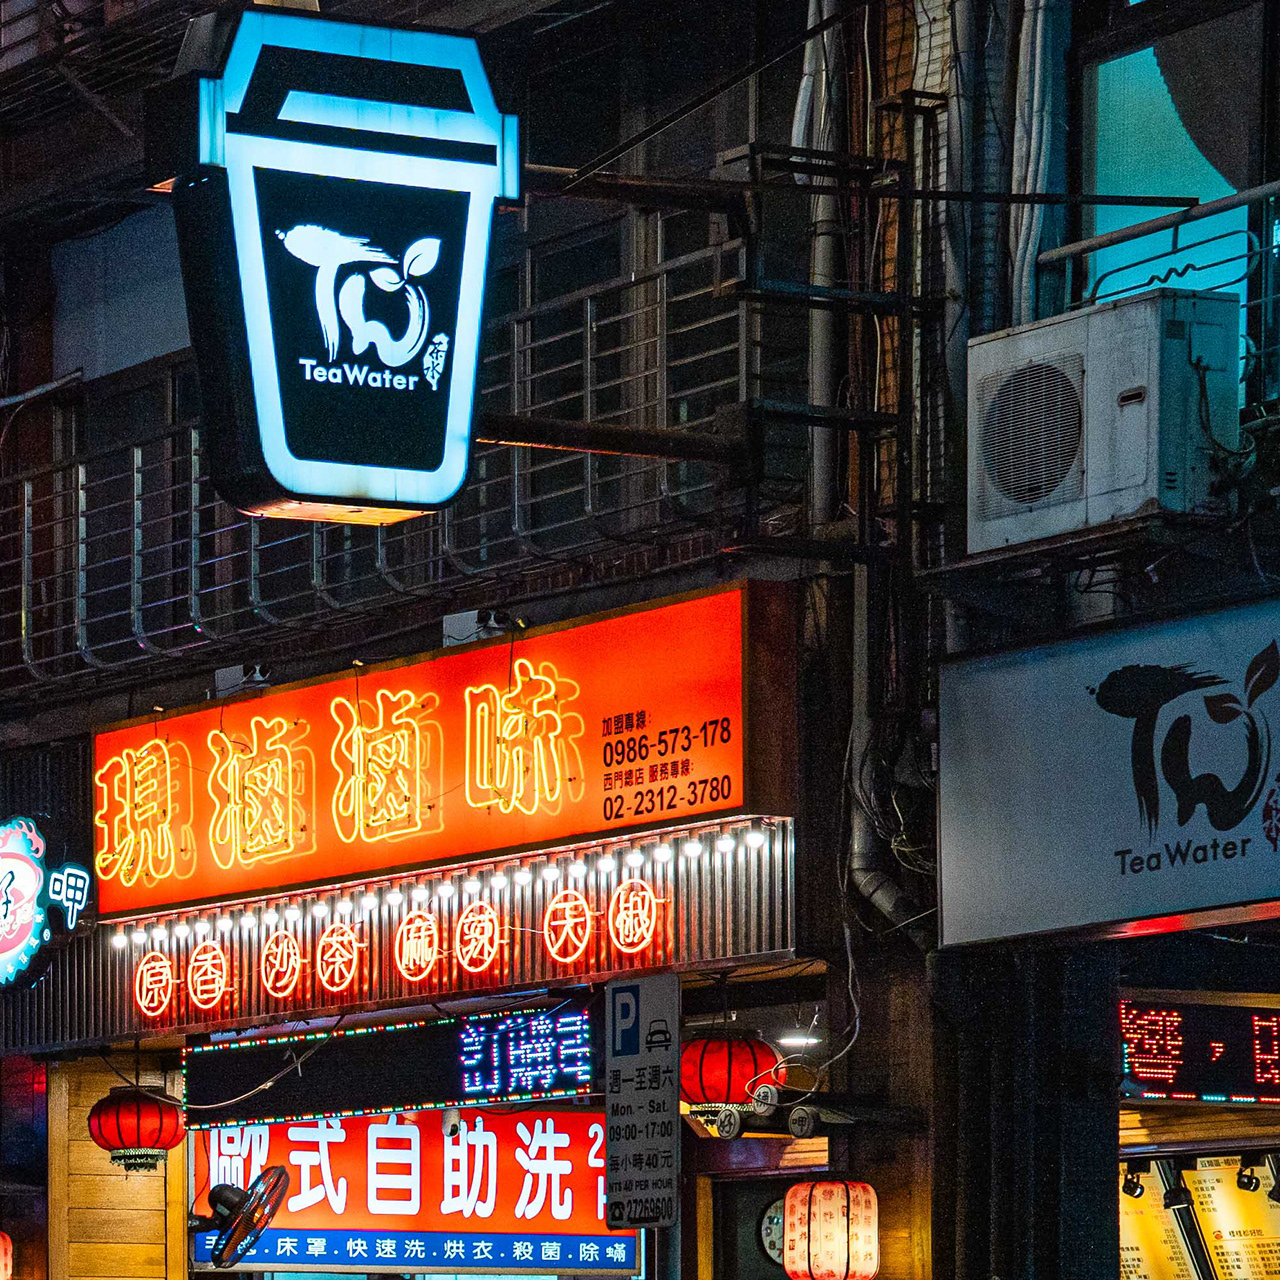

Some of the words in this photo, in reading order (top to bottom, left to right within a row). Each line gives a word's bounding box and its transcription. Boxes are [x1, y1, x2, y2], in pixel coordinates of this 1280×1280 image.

[603, 717, 732, 767] 0986-573-178
[603, 768, 645, 792] 西門總店
[603, 775, 732, 820] 02-2312-3780
[137, 944, 226, 1012] 原香
[261, 923, 357, 997] 沙茶
[396, 902, 499, 980] 麻辣
[615, 992, 636, 1051] P
[609, 1065, 674, 1094] 週一至週六
[611, 1102, 635, 1117] Mon.
[609, 1120, 673, 1142] 09:00-17:00
[624, 1181, 633, 1193] 40
[635, 1179, 650, 1192] PER
[652, 1177, 673, 1190] HOUR
